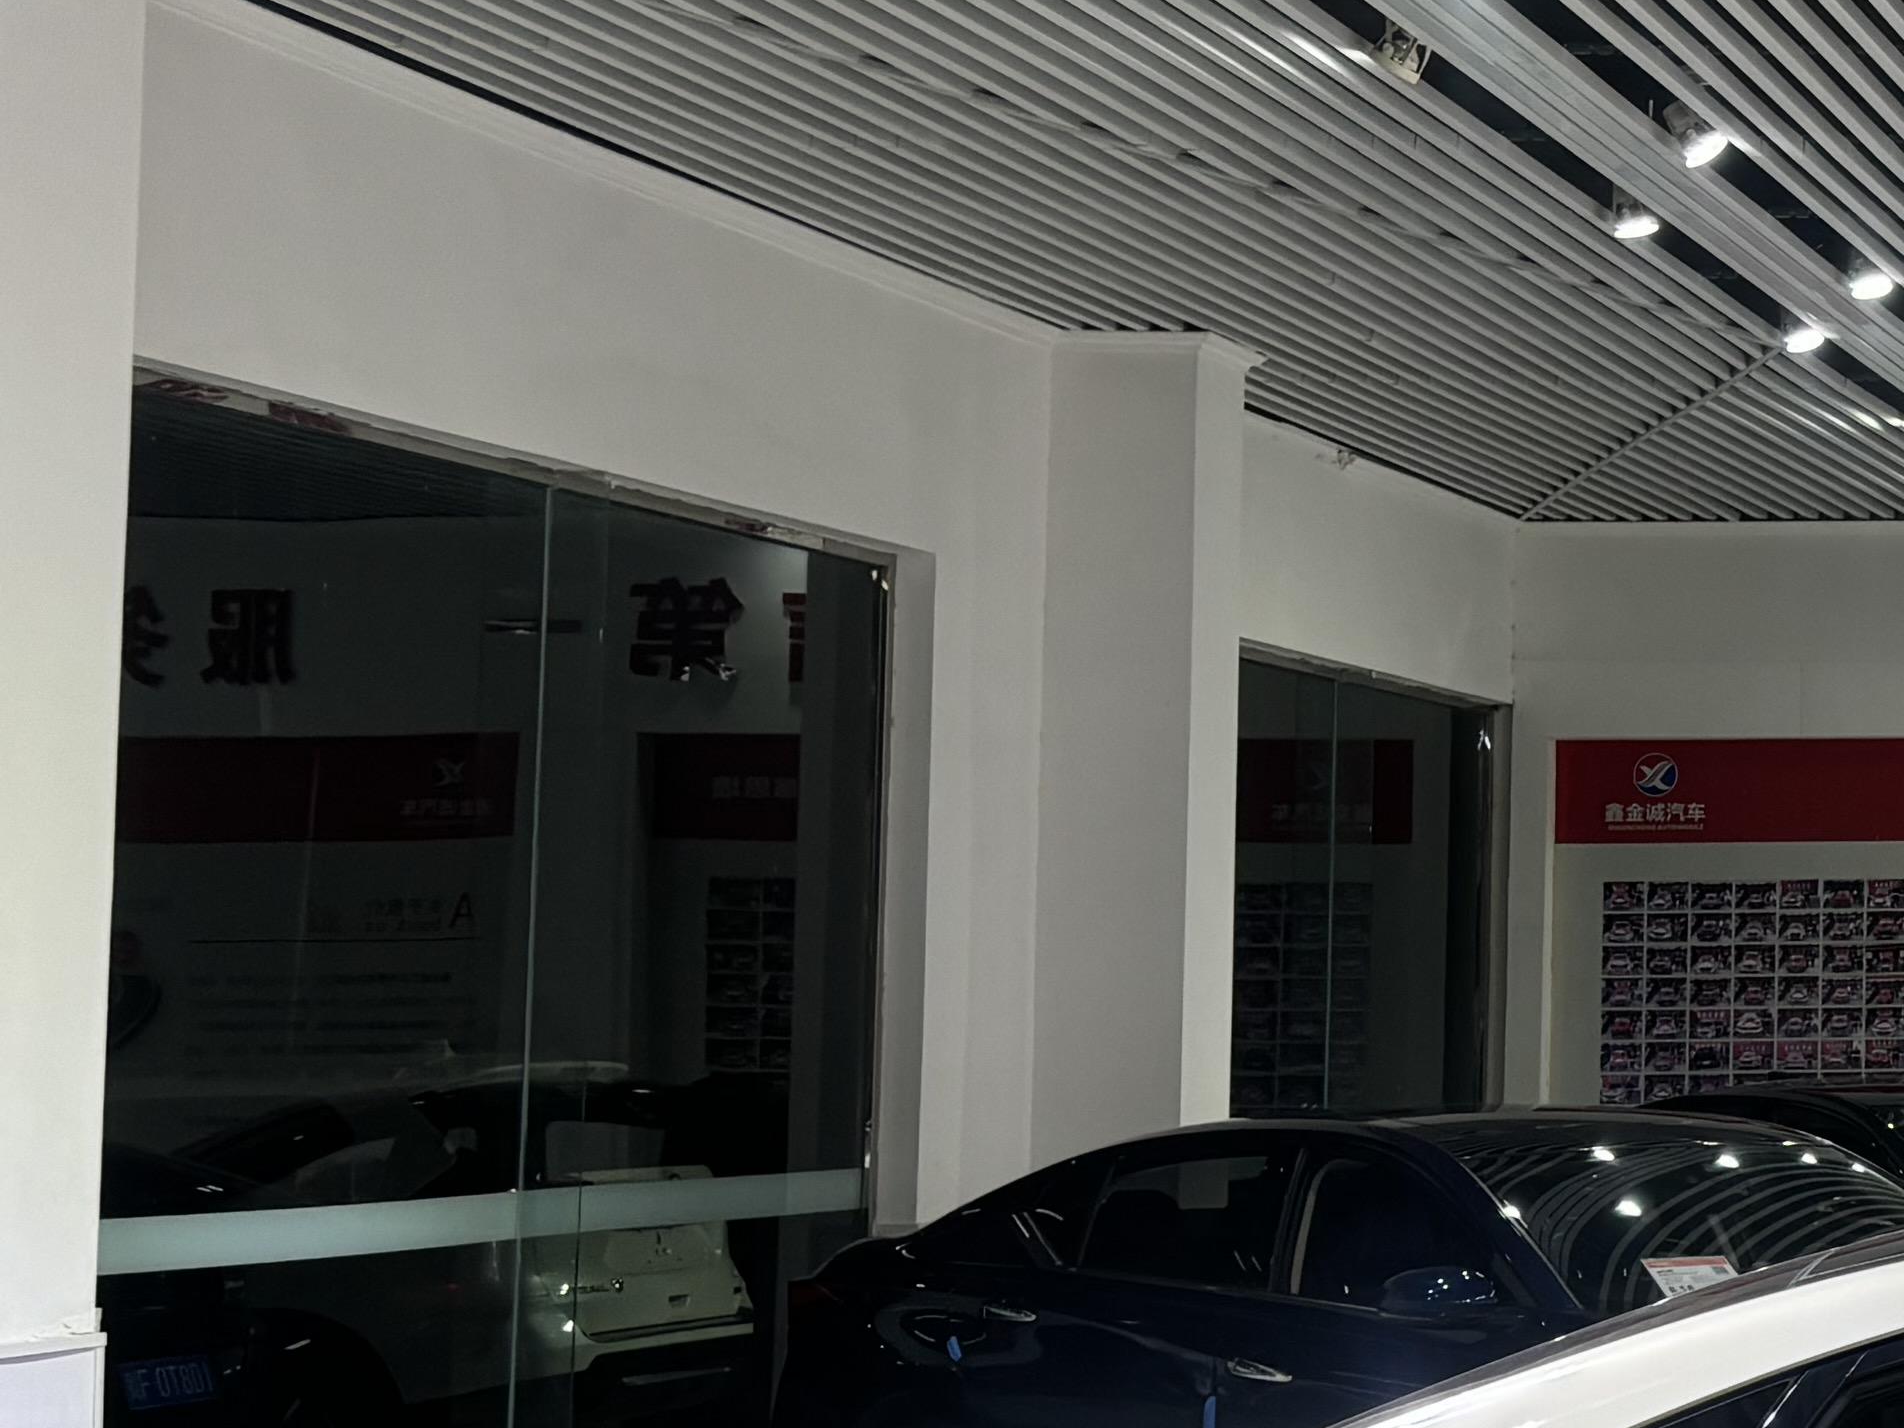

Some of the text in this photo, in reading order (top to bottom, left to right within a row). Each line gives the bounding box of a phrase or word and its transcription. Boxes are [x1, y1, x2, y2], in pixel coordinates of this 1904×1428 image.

[1605, 802, 1706, 822] 鑫金诚汽车
